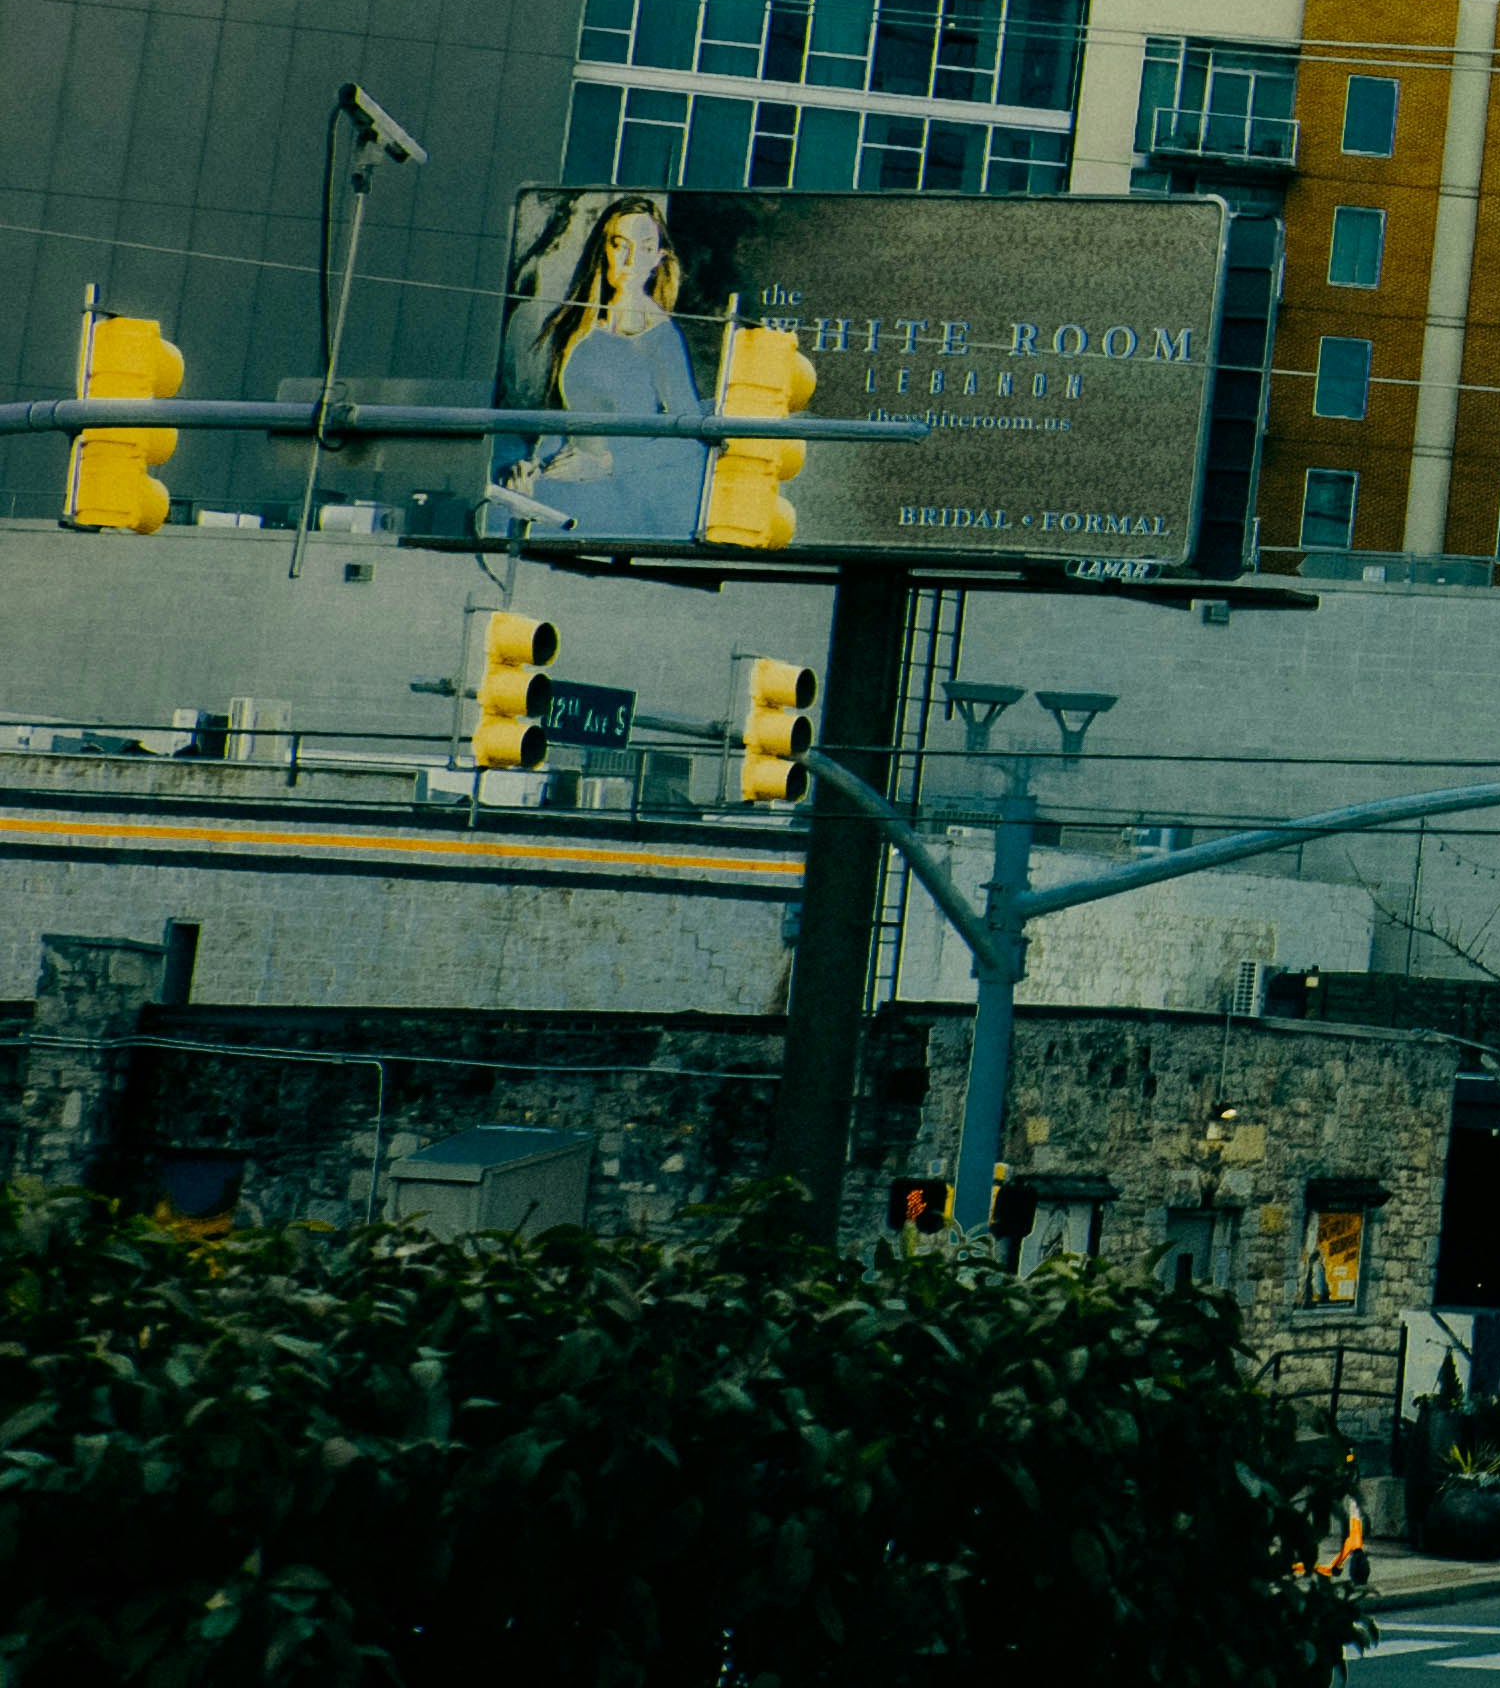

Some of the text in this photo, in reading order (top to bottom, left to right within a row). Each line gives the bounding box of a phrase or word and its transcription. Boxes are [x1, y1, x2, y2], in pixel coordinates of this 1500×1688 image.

[760, 279, 802, 306] the
[1008, 322, 1193, 362] ROOM
[864, 367, 1083, 400] LEBANON
[898, 505, 1172, 537] BRIDAL FORMAL
[1076, 560, 1150, 579] LAMAR
[614, 705, 627, 736] S
